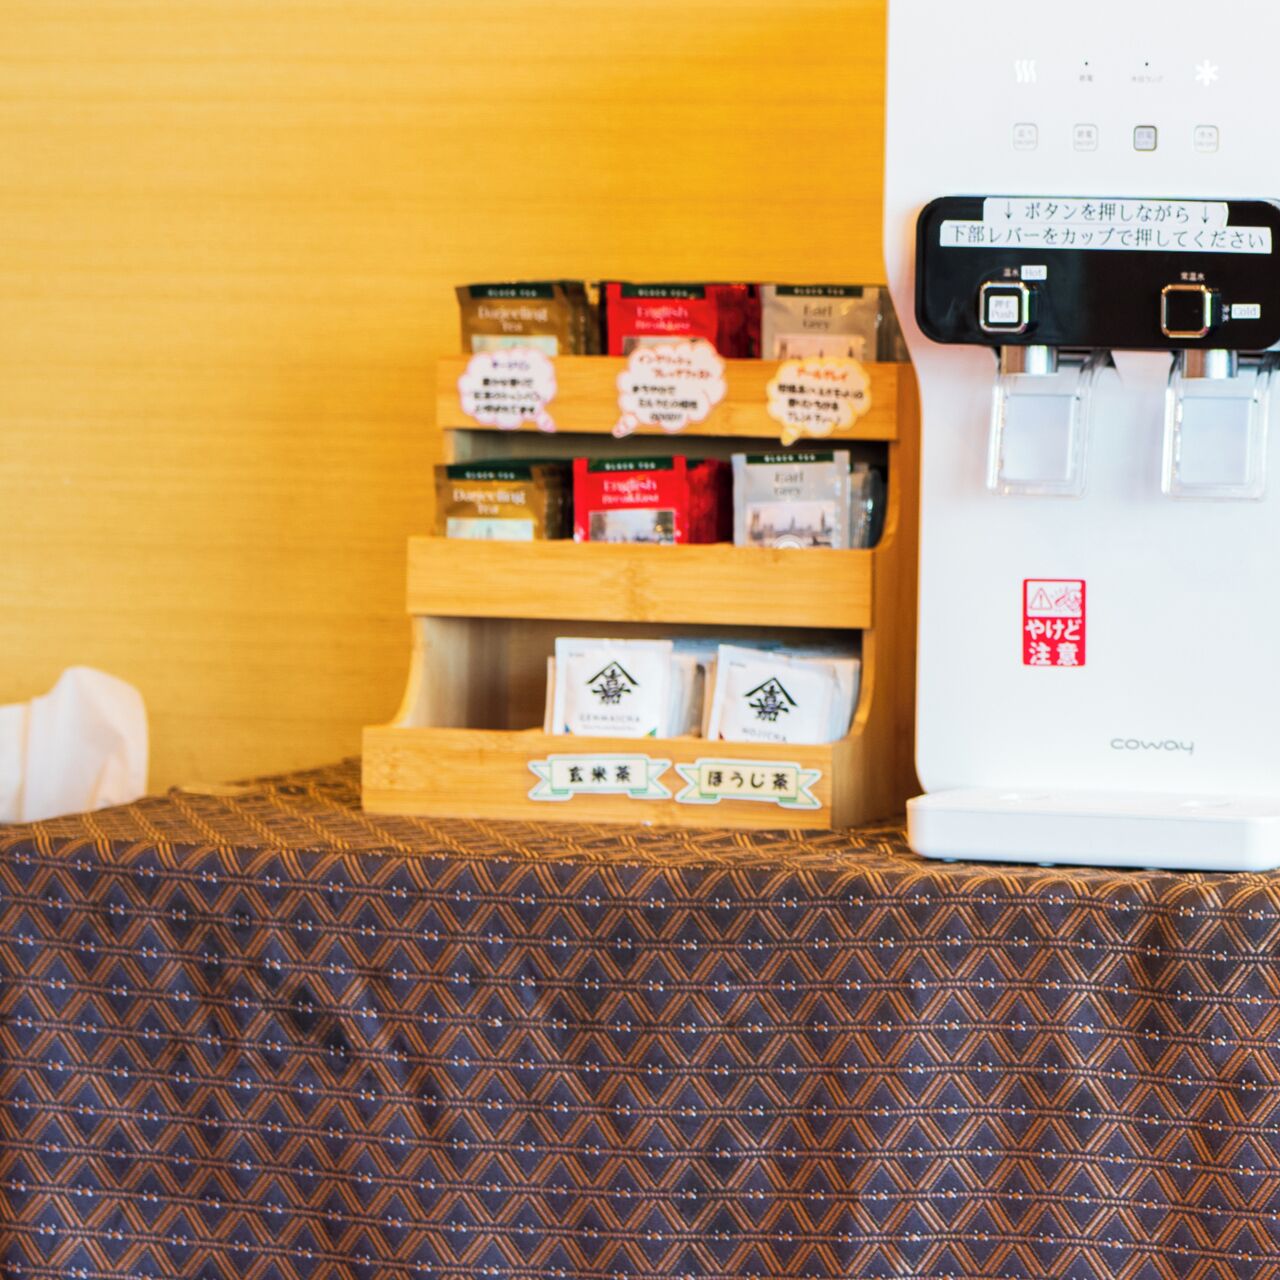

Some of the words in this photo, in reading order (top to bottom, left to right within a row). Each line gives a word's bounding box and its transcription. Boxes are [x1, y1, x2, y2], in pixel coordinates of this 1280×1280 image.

[1025, 203, 1190, 224] ボタンを押しながら
[951, 226, 1264, 249] 下部レバーをカップで押してください
[1025, 619, 1082, 640] やけど
[1029, 642, 1079, 665] 注意
[1110, 738, 1194, 755] coway
[568, 765, 631, 783] 玄米茶
[707, 770, 789, 791] ほうじ茶
